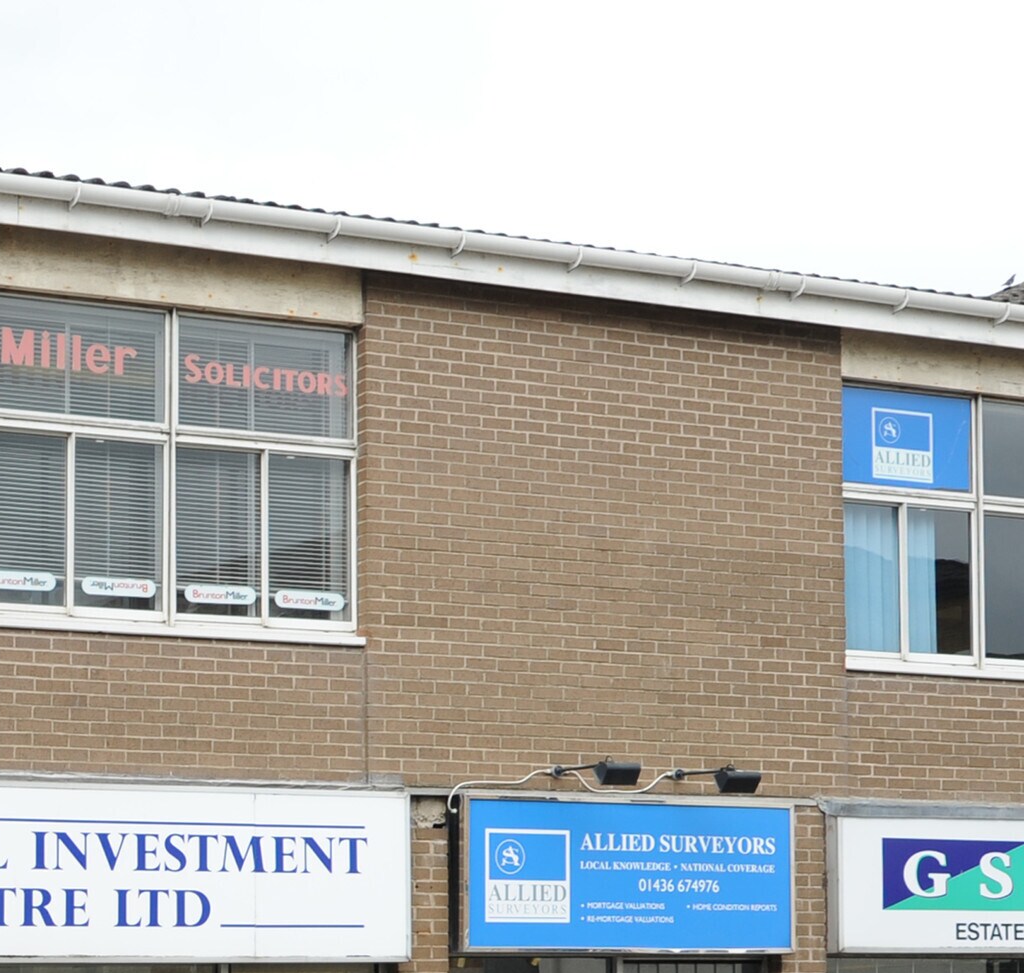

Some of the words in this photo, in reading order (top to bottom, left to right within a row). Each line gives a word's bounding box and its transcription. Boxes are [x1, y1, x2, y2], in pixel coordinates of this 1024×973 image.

[1, 326, 138, 376] Miller
[875, 450, 932, 468] ALLIED
[580, 832, 655, 852] ALLIED
[659, 834, 776, 855] SURVEYORS
[31, 831, 368, 874] INVESTMENT
[580, 861, 611, 870] LOCAL
[613, 861, 671, 871] KNOWLEDGE
[680, 863, 726, 872] NATIONAL
[727, 863, 775, 873] COVERAGE
[488, 883, 567, 902] ALLIED
[638, 878, 675, 892] 01436
[677, 879, 721, 893] 674976
[114, 888, 212, 928] LTD
[488, 903, 567, 915] SURVEYORS
[587, 902, 624, 910] MORTGAGE
[624, 902, 665, 910] VALUATIONS
[750, 904, 778, 912] REPORTS
[587, 915, 633, 923] RE-MORTGAGE
